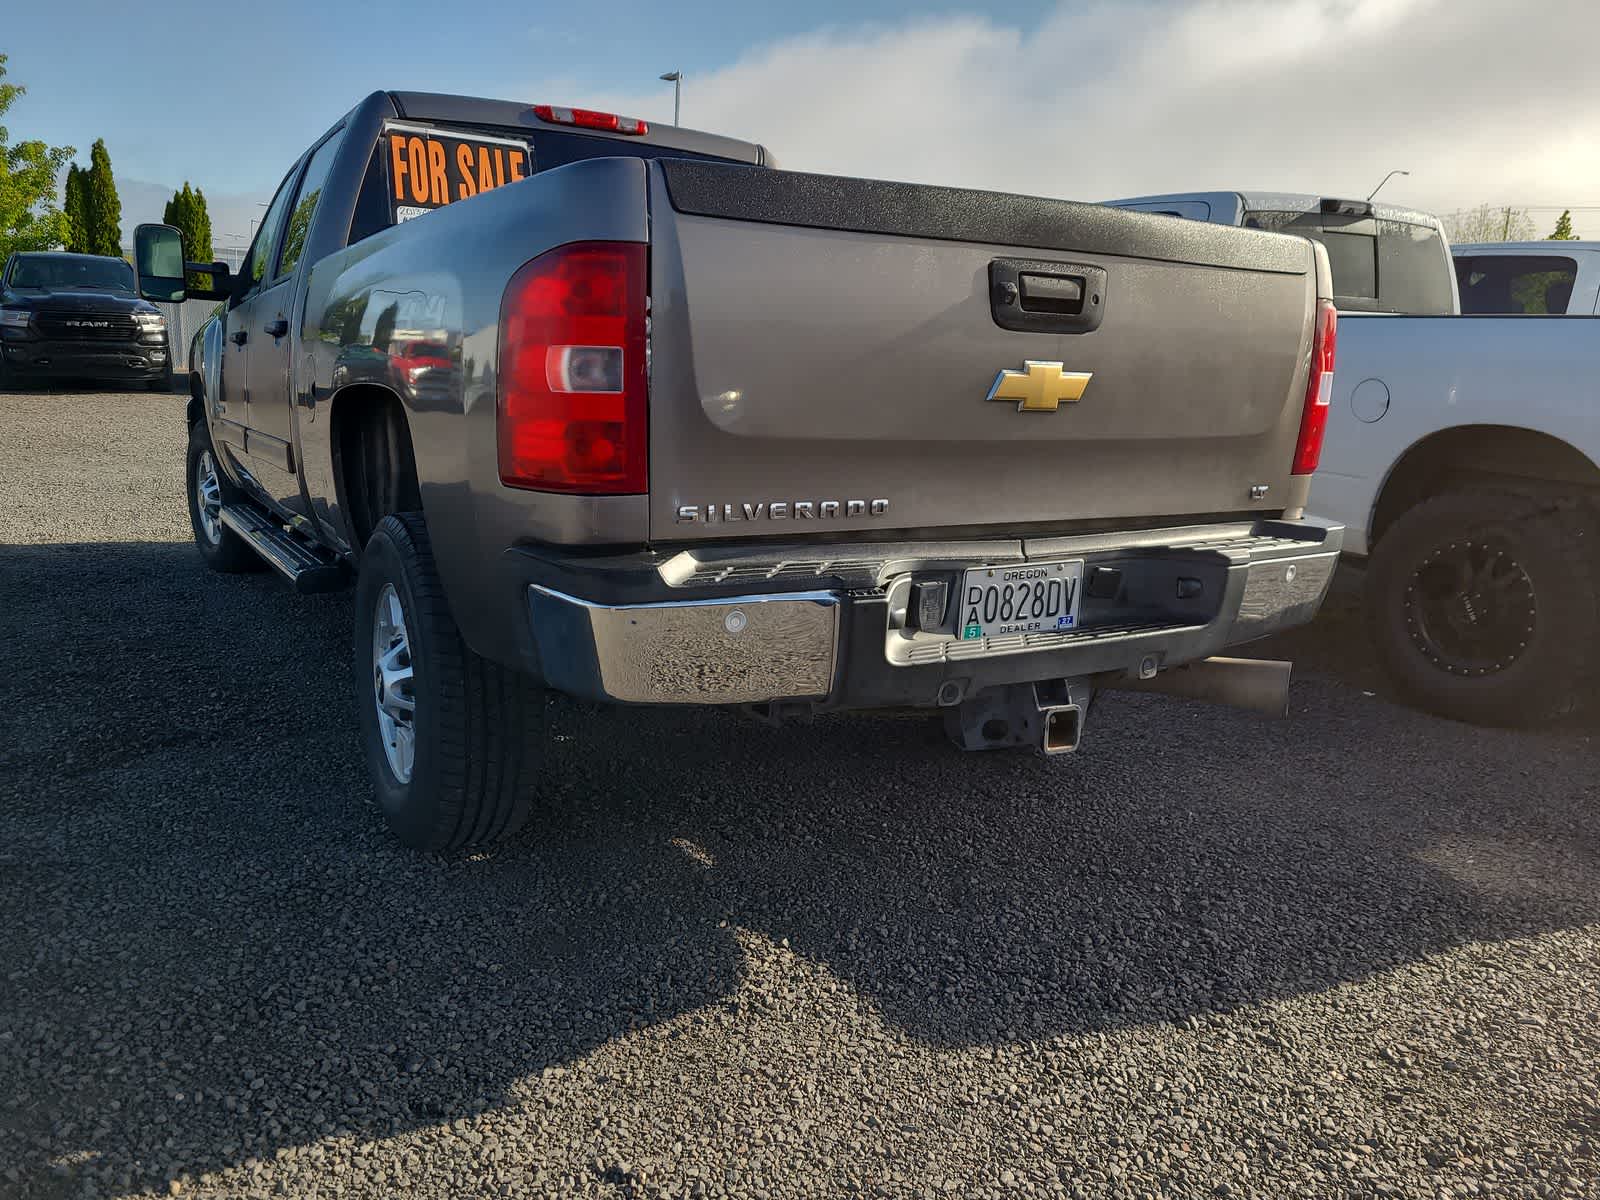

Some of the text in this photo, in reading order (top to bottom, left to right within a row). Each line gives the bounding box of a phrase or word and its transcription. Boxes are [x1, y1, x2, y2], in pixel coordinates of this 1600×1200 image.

[391, 135, 450, 204] FOR
[66, 320, 108, 328] RAM
[678, 499, 889, 523] SILVERADO
[1003, 568, 1048, 581] OREGON
[968, 627, 977, 638] 5
[1000, 622, 1041, 633] DEALER
